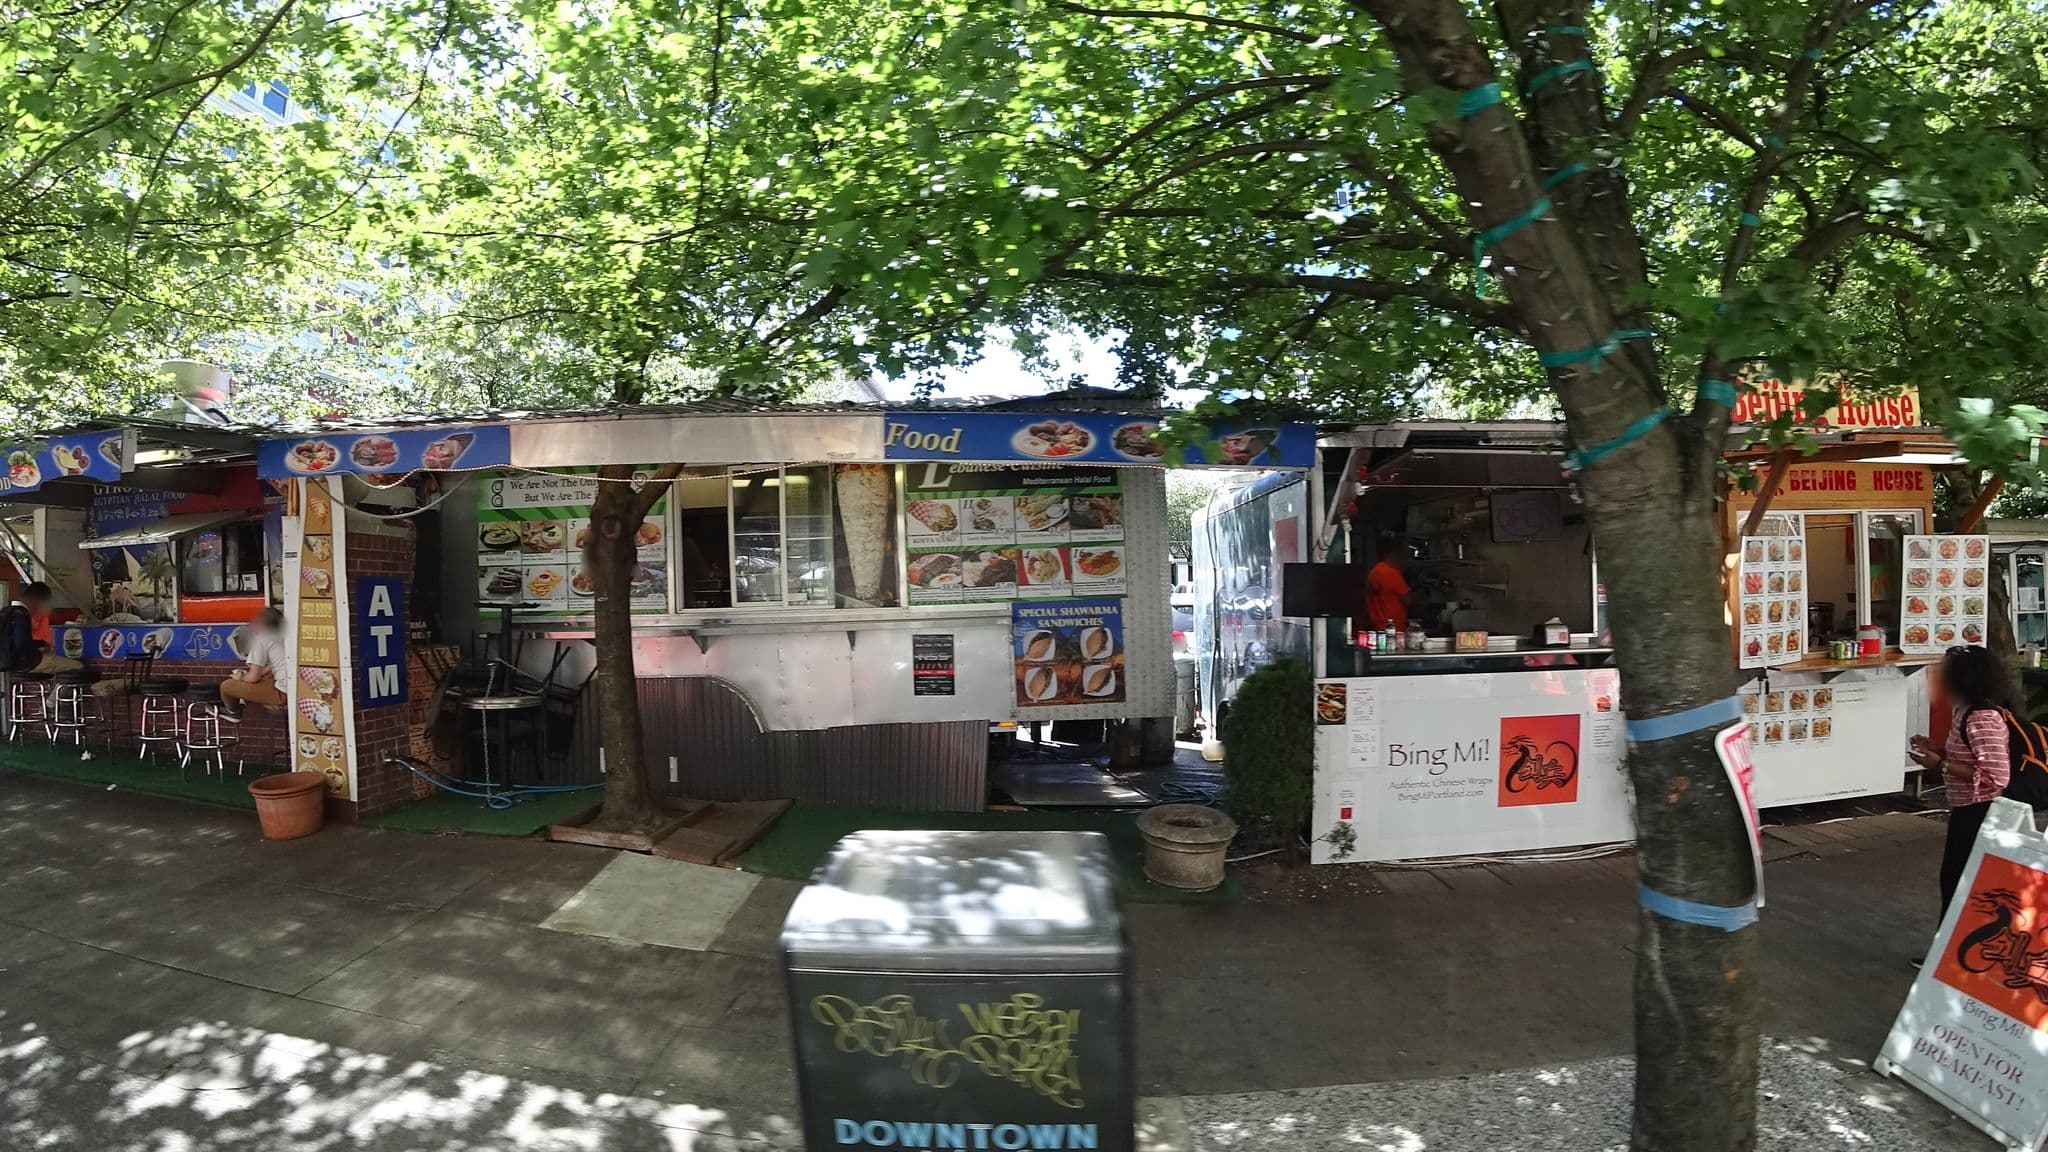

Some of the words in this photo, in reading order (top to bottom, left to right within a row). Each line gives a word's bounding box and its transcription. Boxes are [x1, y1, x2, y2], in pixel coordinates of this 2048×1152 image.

[884, 422, 963, 453] Food
[510, 480, 524, 490] We
[526, 479, 539, 489] Are
[542, 479, 558, 489] Not
[561, 477, 578, 487] The
[1093, 474, 1111, 483] Food
[1789, 469, 1857, 491] BEIJING
[1873, 470, 1924, 492] HOUSE
[525, 493, 539, 503] But
[541, 492, 554, 501] We
[557, 491, 572, 501] Are
[575, 490, 592, 500] The
[569, 521, 576, 530] 5
[1073, 549, 1087, 560] 16
[1018, 608, 1058, 618] SPECIAL
[1059, 606, 1119, 617] SHAWARMA
[1037, 617, 1105, 628] SANDWICHES
[367, 584, 400, 699] ATM
[1387, 742, 1449, 776] Bing
[1453, 739, 1490, 763] Mi!
[1388, 777, 1431, 790] Authentic
[1433, 776, 1467, 788] Chinese
[1467, 777, 1494, 788] Wraps
[1962, 999, 1999, 1031] Bing
[1999, 1017, 2026, 1040] Mi!
[1933, 1024, 1985, 1059] OPEN
[1983, 1052, 2024, 1084] FOR
[1913, 1037, 2026, 1111] BREAKFAST!
[833, 1118, 1098, 1149] DOWNTOWN
